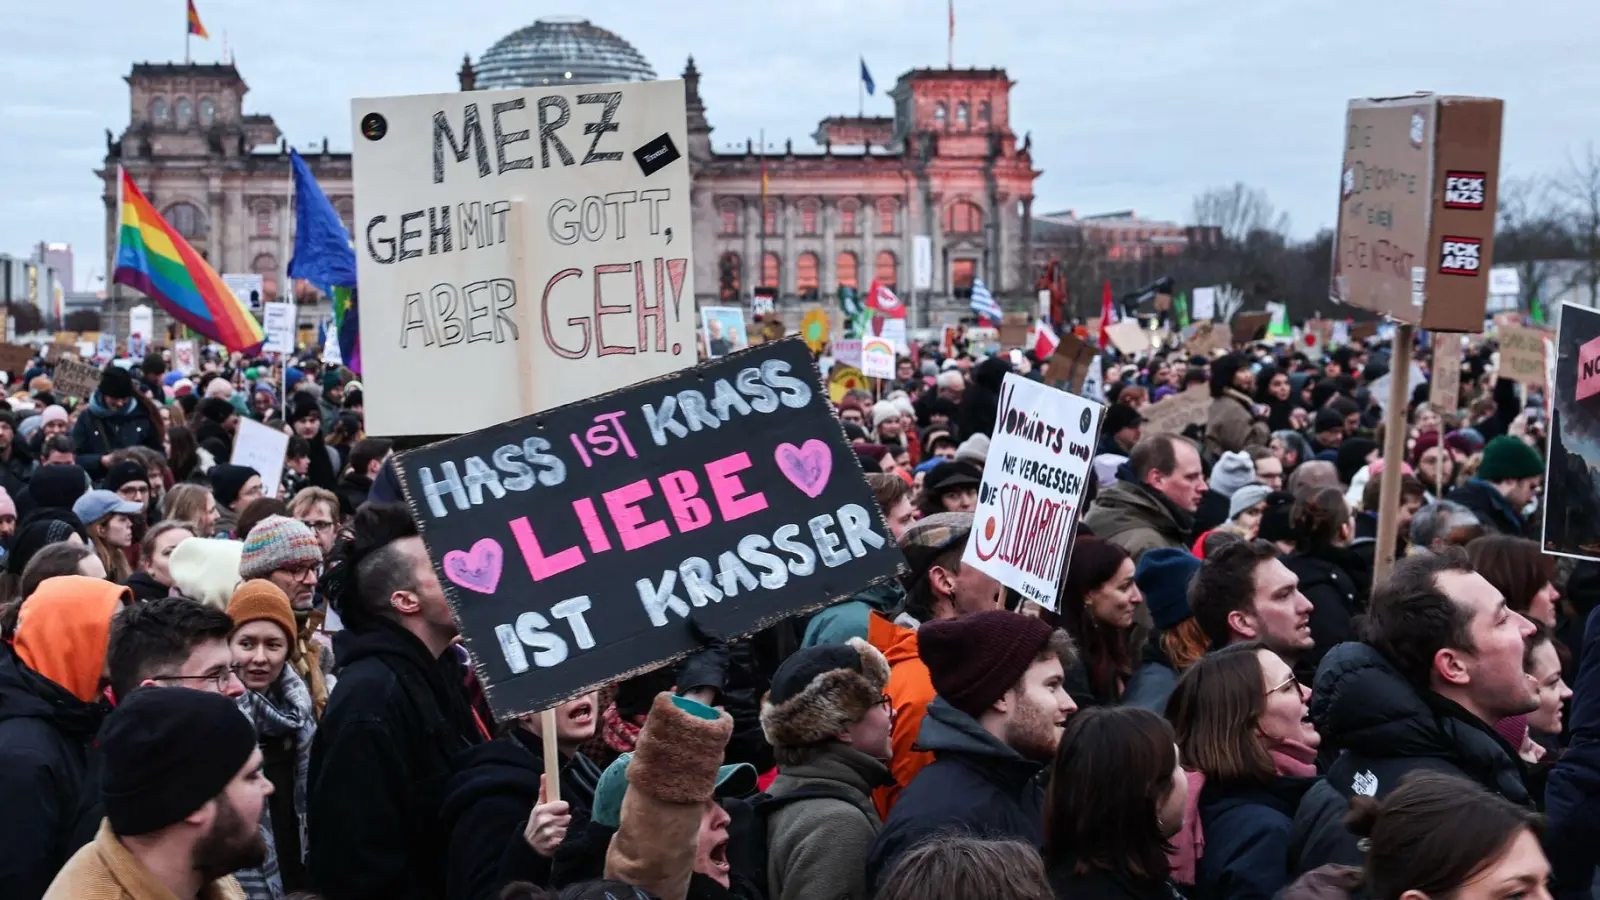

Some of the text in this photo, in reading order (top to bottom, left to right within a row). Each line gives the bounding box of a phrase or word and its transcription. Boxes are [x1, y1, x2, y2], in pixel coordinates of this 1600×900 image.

[432, 91, 624, 184] MERZ
[1445, 190, 1483, 204] NZS
[1446, 177, 1484, 191] FCK
[366, 188, 673, 264] GEH MIT GOTT,
[1443, 242, 1480, 257] FCK
[1441, 255, 1480, 270] AFD
[399, 277, 519, 349] ABER
[540, 257, 688, 359] GEH!
[417, 358, 812, 519] HASS IST KRASS
[1001, 451, 1017, 476] NIE
[507, 451, 770, 582] LIEBE
[980, 481, 998, 506] DIE
[493, 503, 886, 675] IST KRASSER
